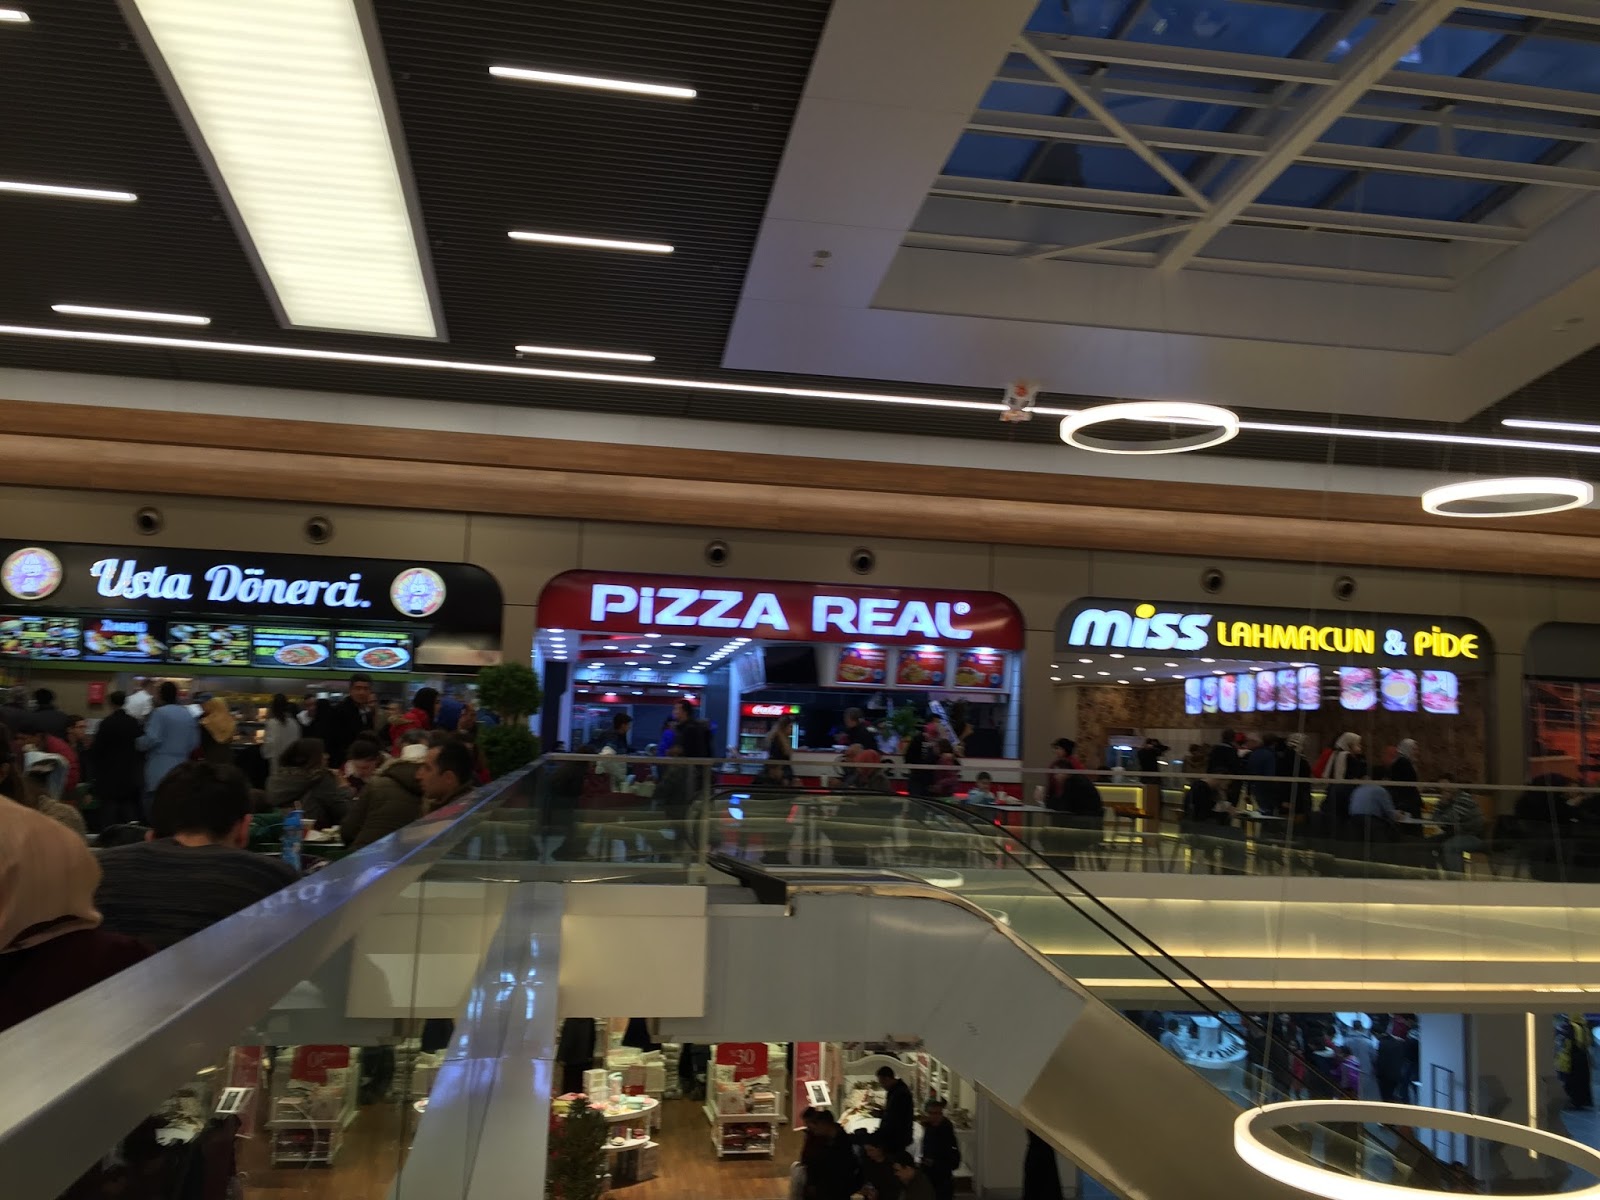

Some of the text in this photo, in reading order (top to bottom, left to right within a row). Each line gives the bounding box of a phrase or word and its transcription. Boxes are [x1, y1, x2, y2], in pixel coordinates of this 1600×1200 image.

[90, 559, 371, 607] Usta Dönerci.
[1217, 621, 1375, 655] LAHMACUN
[1383, 629, 1408, 656] &
